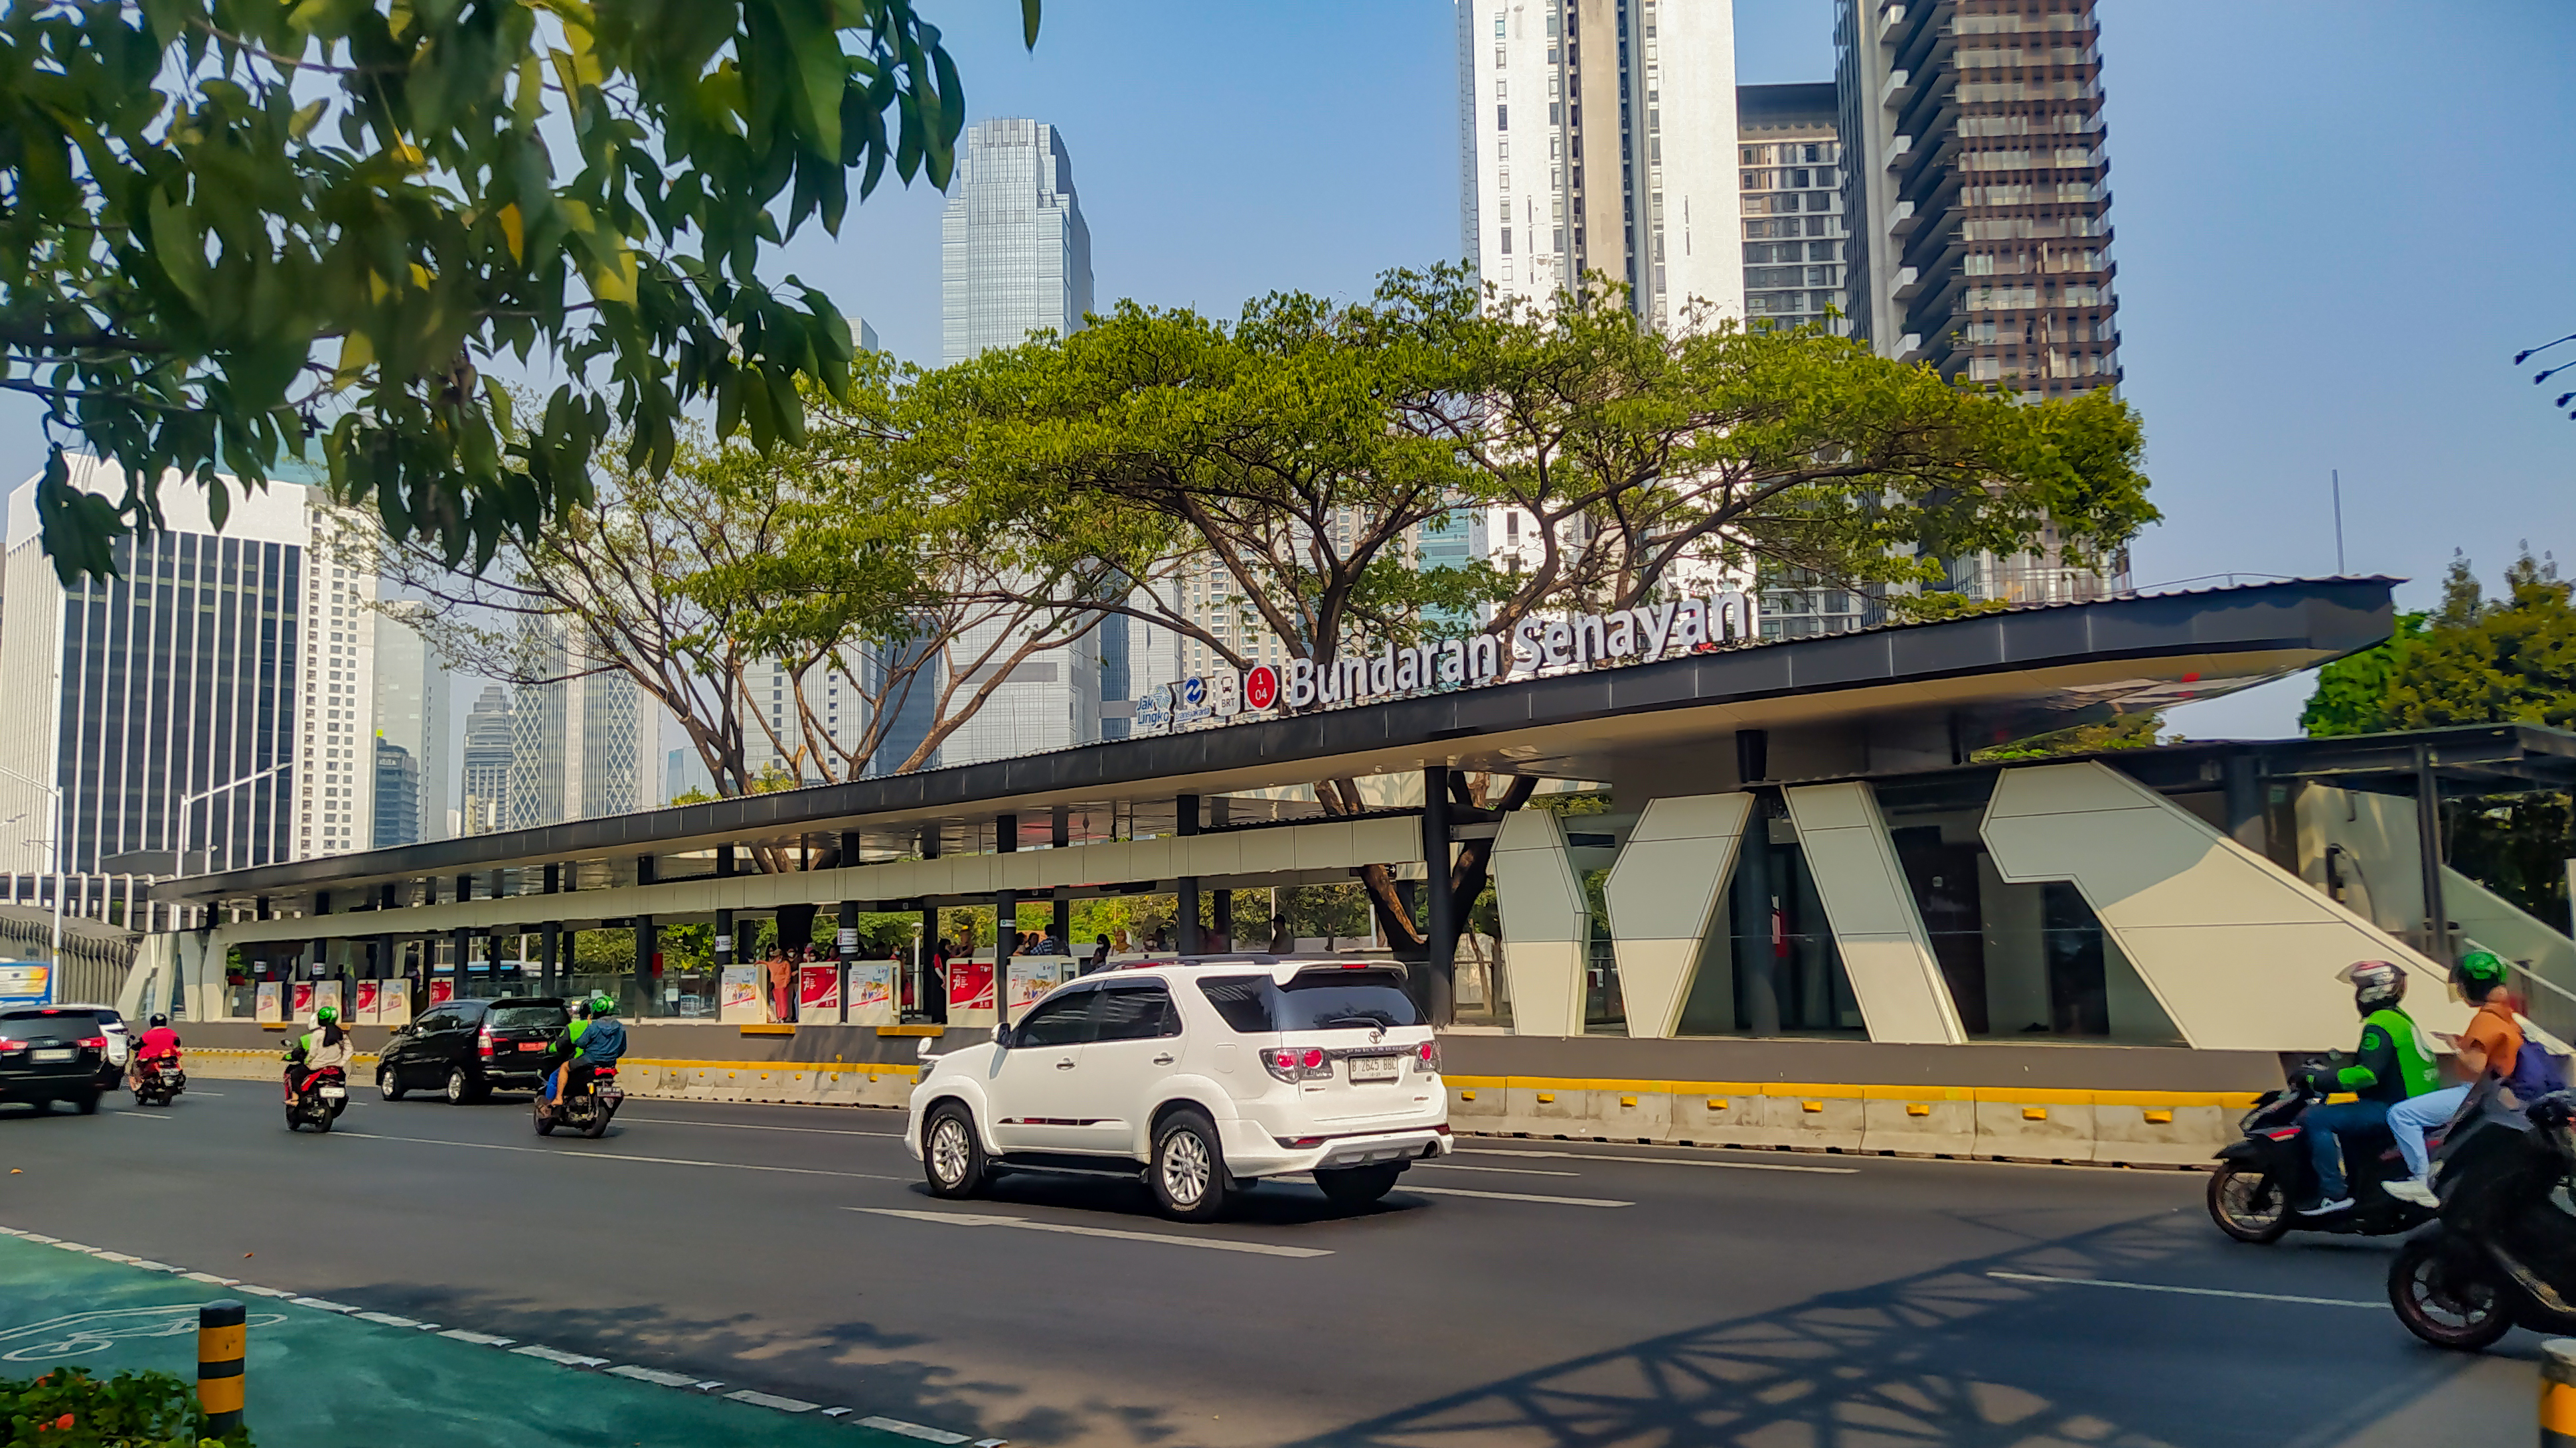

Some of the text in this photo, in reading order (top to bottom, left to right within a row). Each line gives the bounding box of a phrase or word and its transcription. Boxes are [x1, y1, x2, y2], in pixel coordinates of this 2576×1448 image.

[1290, 592, 1747, 708] Bundaran Senayan
[1257, 673, 1263, 685] 1
[1255, 688, 1267, 700] 04
[1137, 696, 1154, 711] Jak
[1221, 698, 1236, 708] BRT
[1138, 709, 1169, 726] Lingko
[1352, 1058, 1396, 1072] B 2645 BBC
